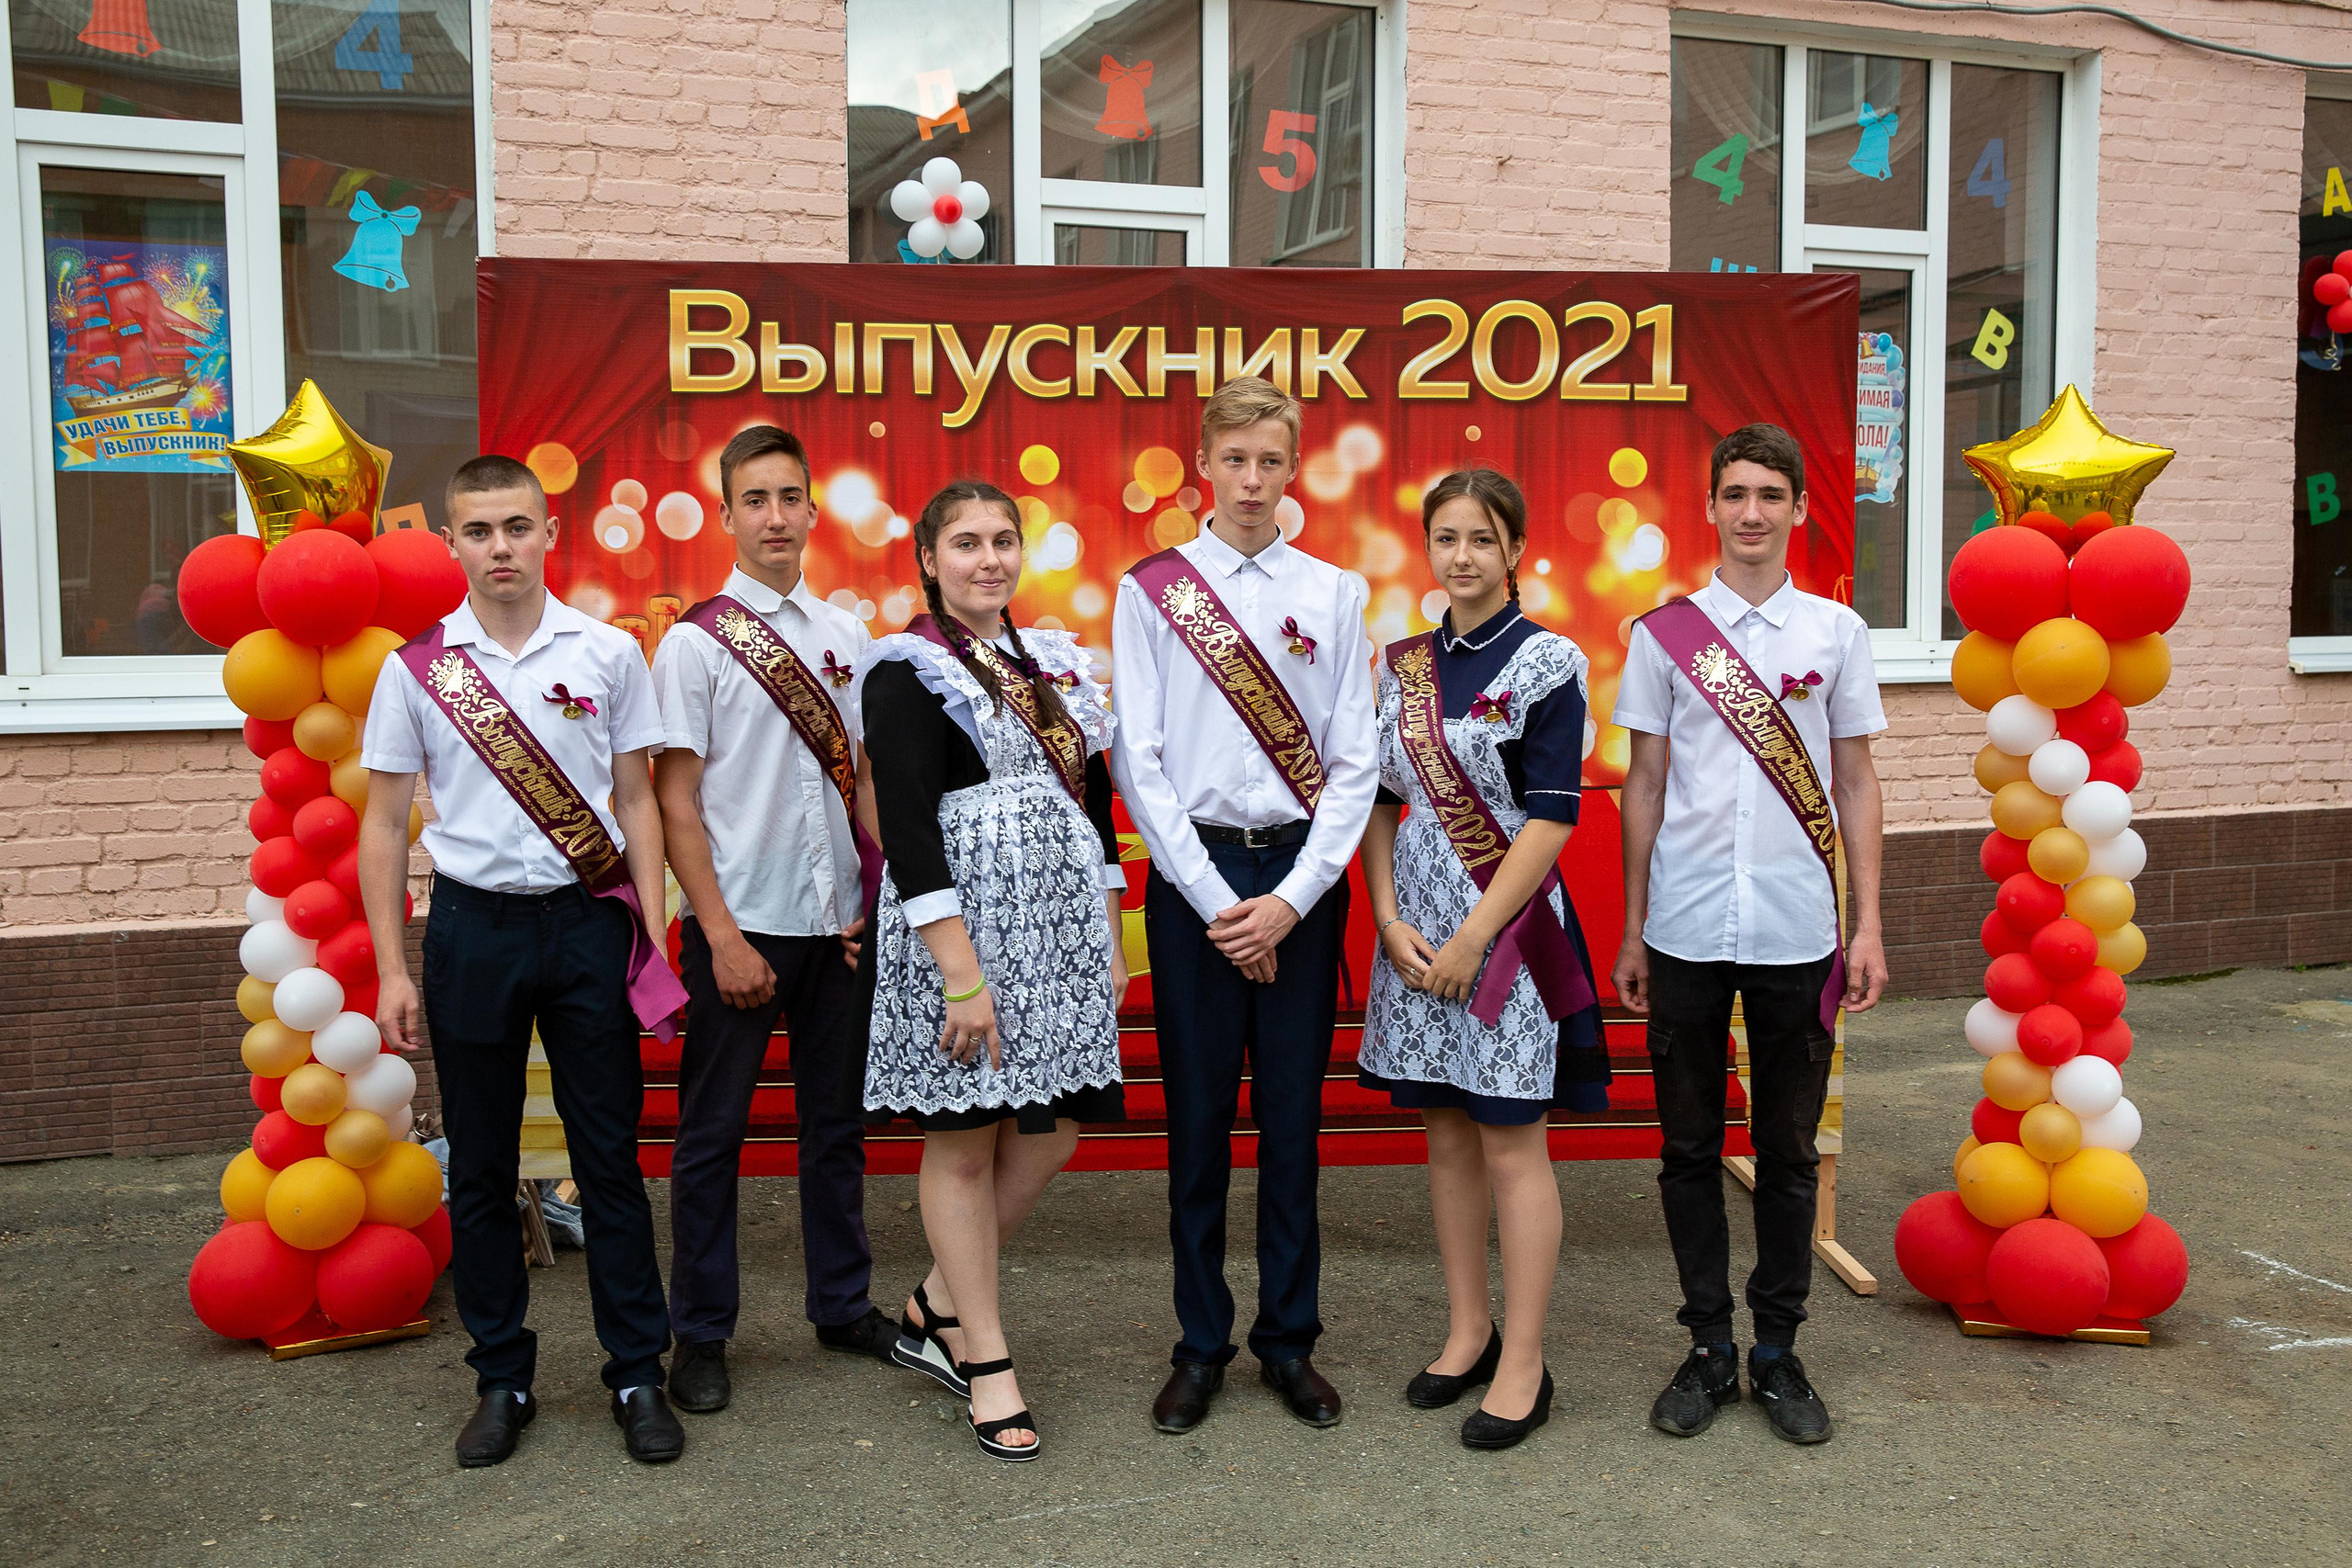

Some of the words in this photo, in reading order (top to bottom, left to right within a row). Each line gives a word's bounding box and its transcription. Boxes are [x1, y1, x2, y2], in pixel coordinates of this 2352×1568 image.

[335, 0, 413, 89] 4
[1258, 109, 1317, 193] 5
[1691, 132, 1749, 206] 4
[1966, 138, 2010, 208] 4
[668, 288, 1368, 428] Выпускник
[1397, 299, 1688, 401] 2021
[1858, 361, 1887, 377] ИДАНИЯ,
[65, 415, 130, 439] УДАЧИ
[134, 411, 187, 428] ТЕБЕ,
[1856, 423, 1890, 449] ОЛА!
[1857, 389, 1891, 410] ИМАЯ
[103, 435, 227, 456] ВЫПУСКНИК!
[1194, 621, 1295, 742] Выпускник
[459, 697, 573, 820] Выпускник
[549, 809, 619, 885] 2021
[1435, 795, 1507, 872] 2021
